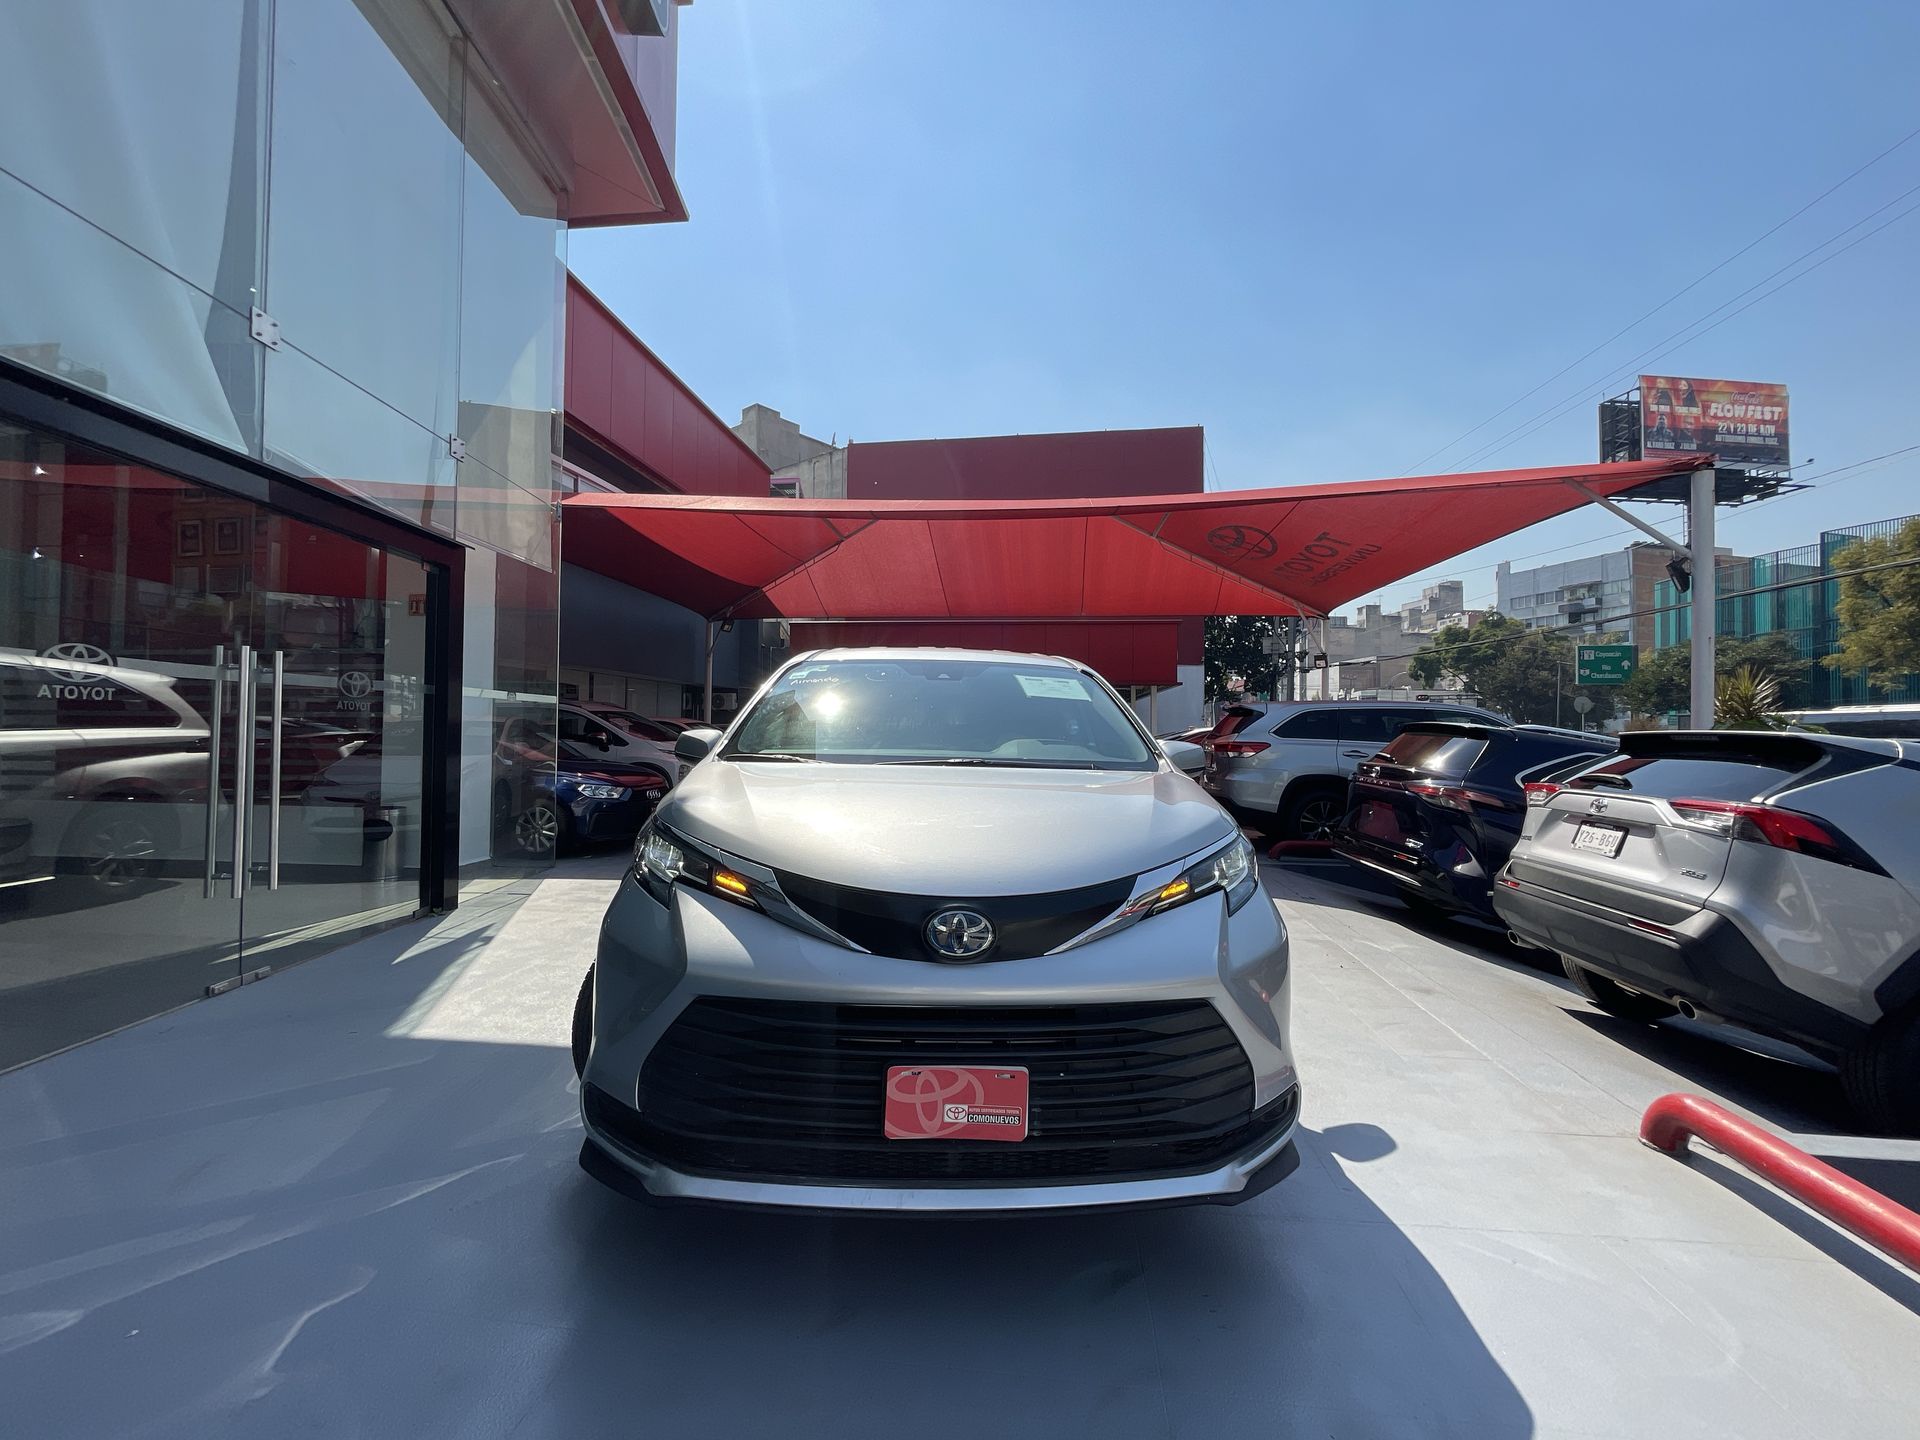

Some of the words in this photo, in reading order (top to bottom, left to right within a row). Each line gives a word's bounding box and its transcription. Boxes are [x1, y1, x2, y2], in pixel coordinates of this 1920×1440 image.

[1709, 402, 1745, 418] FLOW
[1747, 405, 1783, 421] FEST
[1718, 422, 1728, 434] 22
[1736, 424, 1746, 435] 23
[1748, 424, 1758, 436] DE
[968, 1114, 1020, 1125] COMONUEVOS
